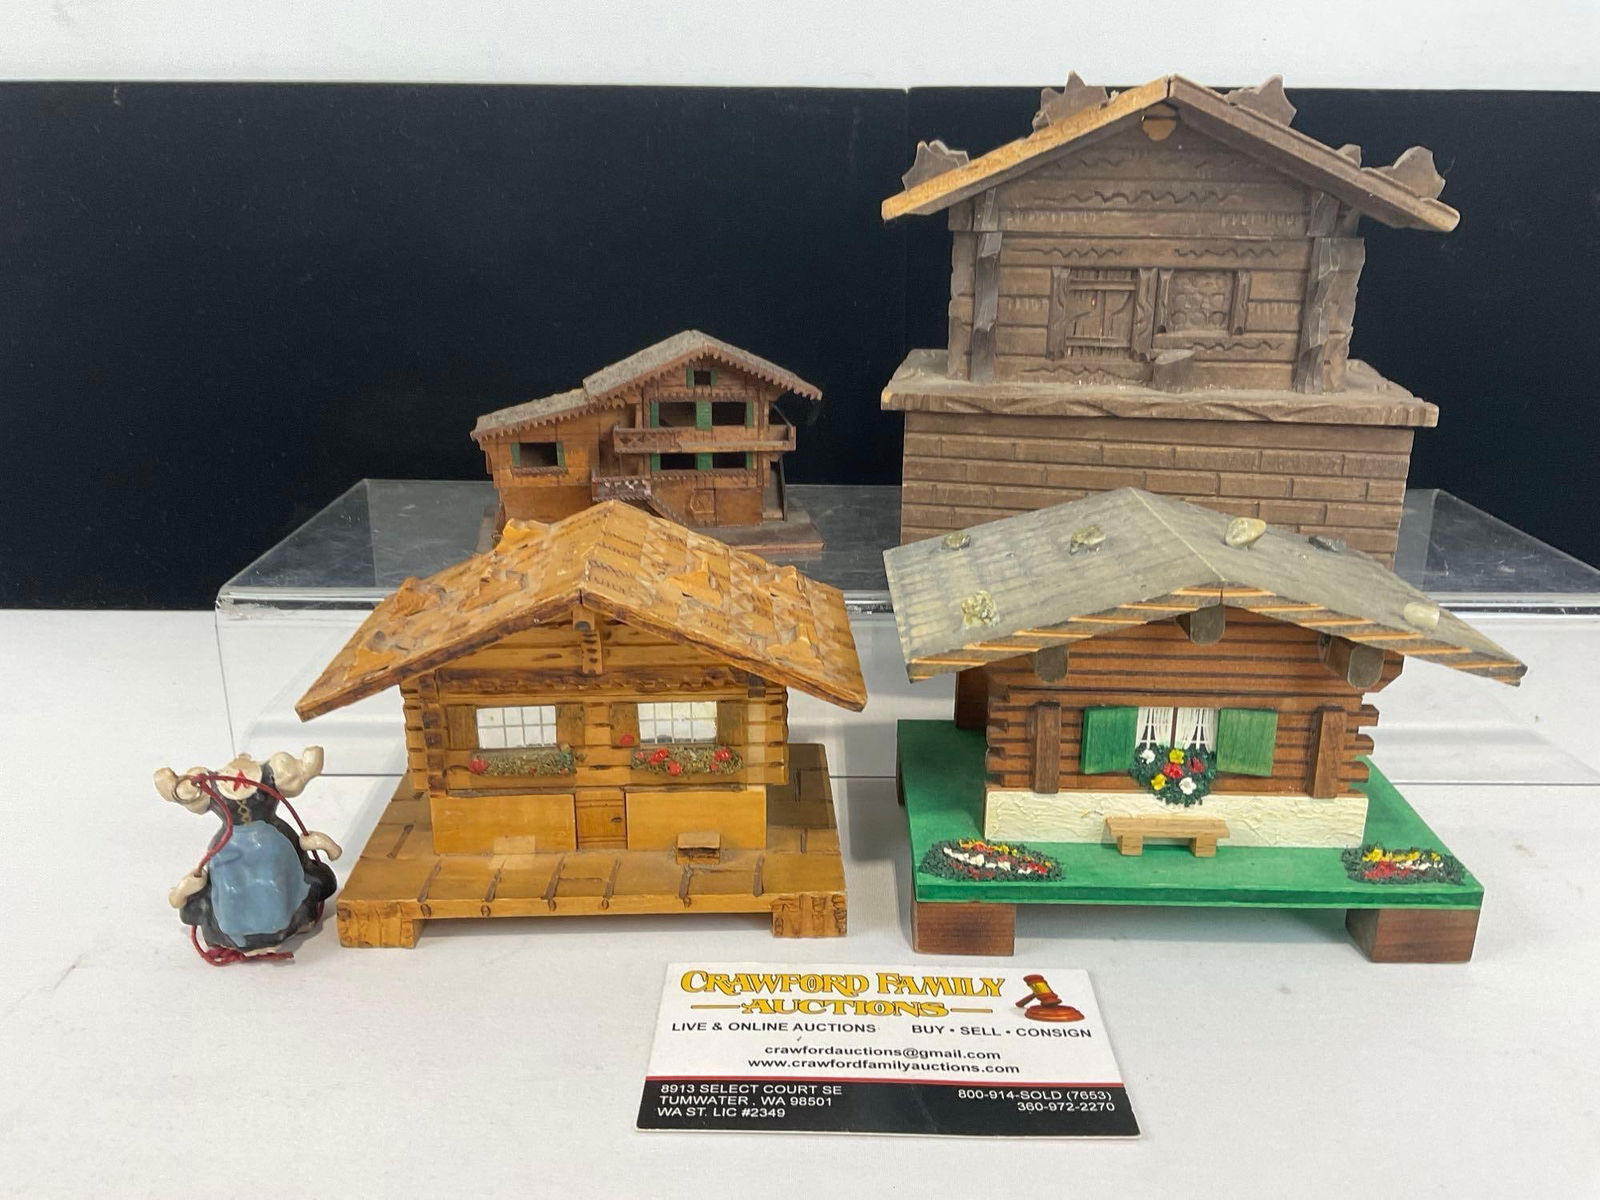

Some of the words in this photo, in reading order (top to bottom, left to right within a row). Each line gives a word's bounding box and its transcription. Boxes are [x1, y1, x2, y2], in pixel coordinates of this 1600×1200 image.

[680, 970, 870, 997] CRAWFORD
[876, 972, 1006, 998] FAMILY
[741, 998, 949, 1018] AUCTIONS
[671, 1022, 707, 1032] LIVE
[712, 1022, 723, 1032] &
[728, 1022, 788, 1032] ONLINE
[792, 1023, 876, 1033] AUCTIONS
[911, 1024, 945, 1034] BUY
[960, 1026, 1001, 1036] SELL
[1016, 1028, 1092, 1038] CONSIGN
[764, 1045, 1001, 1060] crawfordauctions@gmail.com
[748, 1059, 1020, 1074] www.crawfordfamilyauctions.com
[660, 1084, 695, 1094] 8913
[699, 1084, 759, 1094] SELECT
[763, 1085, 817, 1095] COURT
[822, 1085, 842, 1095] SE
[958, 1089, 1062, 1100] 800-914-SOLD
[1066, 1090, 1112, 1101] (7653)
[760, 1096, 786, 1106] WA
[790, 1097, 832, 1107] 98501
[1017, 1102, 1115, 1112] 360-972-2270
[657, 1107, 683, 1117] WA
[686, 1107, 708, 1117] ST.
[713, 1107, 737, 1117] LIC
[741, 1107, 786, 1118] #2349
